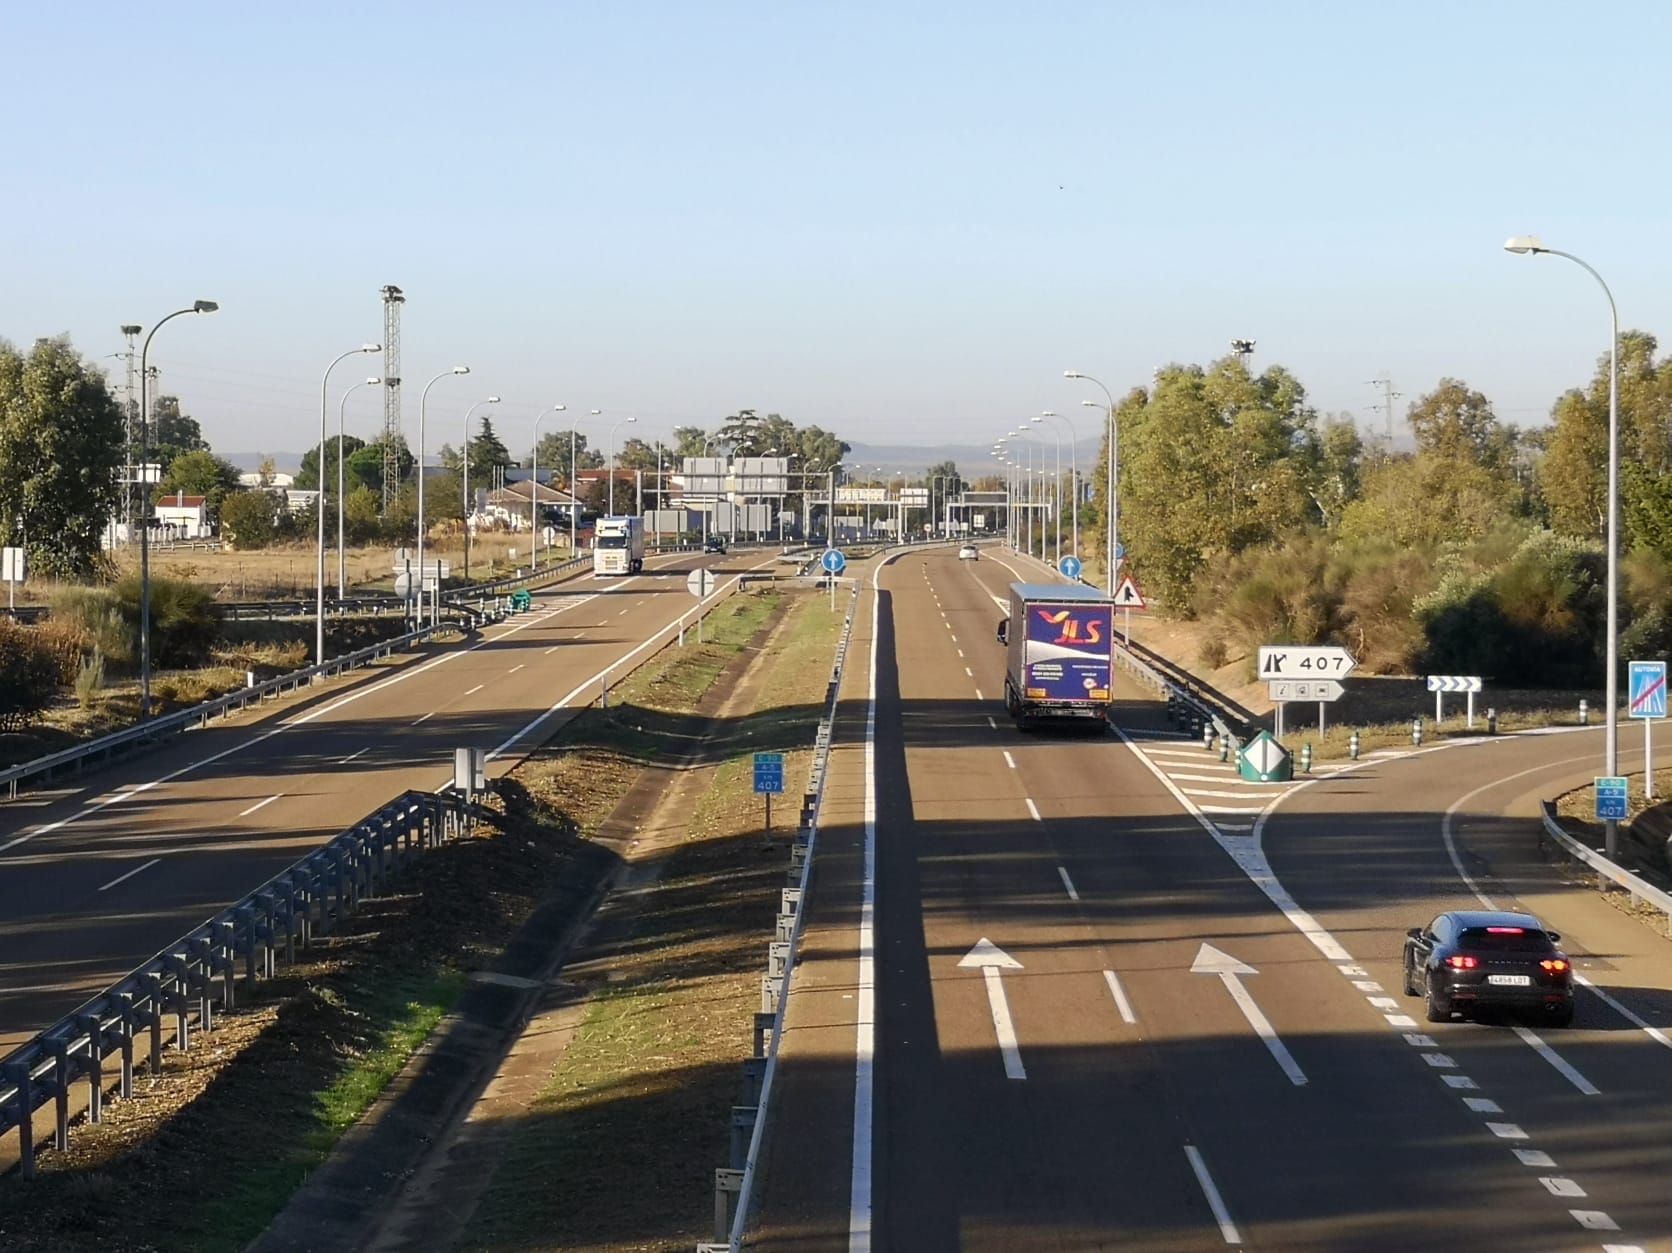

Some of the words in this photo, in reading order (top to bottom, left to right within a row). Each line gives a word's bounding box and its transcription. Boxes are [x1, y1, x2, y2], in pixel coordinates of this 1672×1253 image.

[1299, 656, 1344, 671] 407
[757, 781, 779, 790] 407
[1599, 806, 1623, 816] 407
